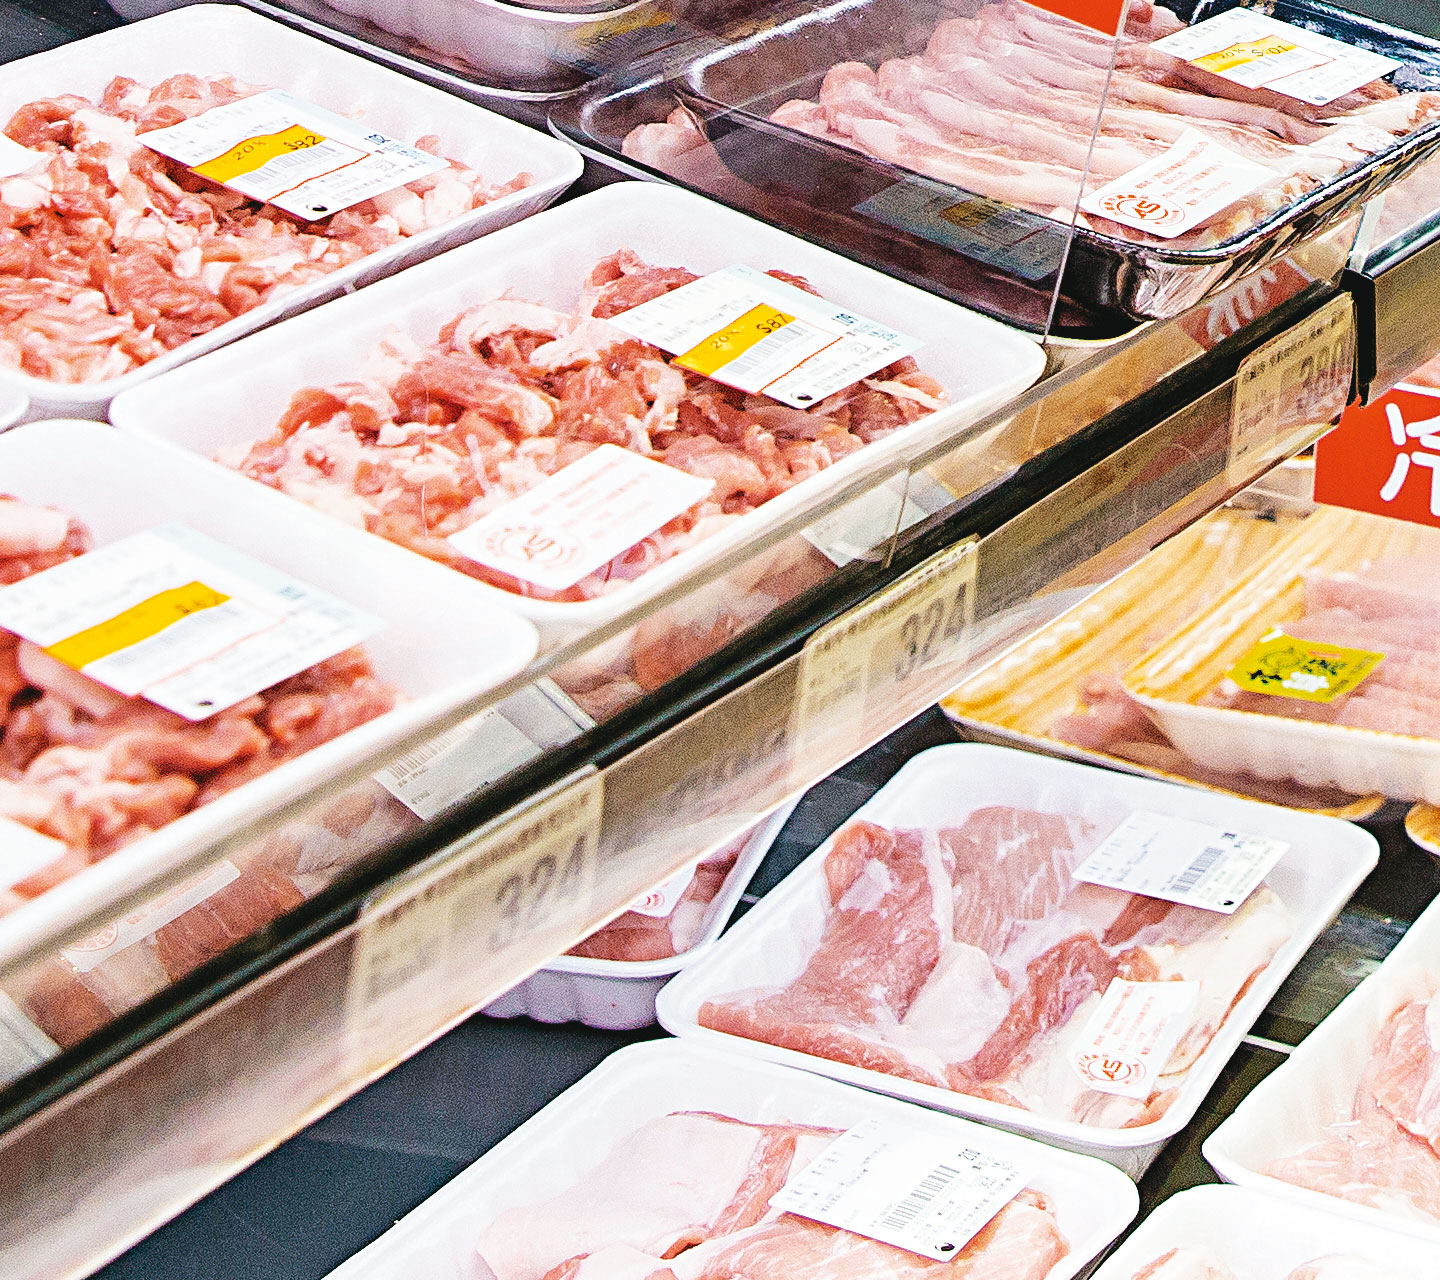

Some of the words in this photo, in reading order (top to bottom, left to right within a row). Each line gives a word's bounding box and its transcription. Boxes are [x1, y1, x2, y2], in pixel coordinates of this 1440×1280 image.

[757, 314, 788, 335] $87
[895, 583, 972, 682] 324
[488, 832, 589, 952] 324
